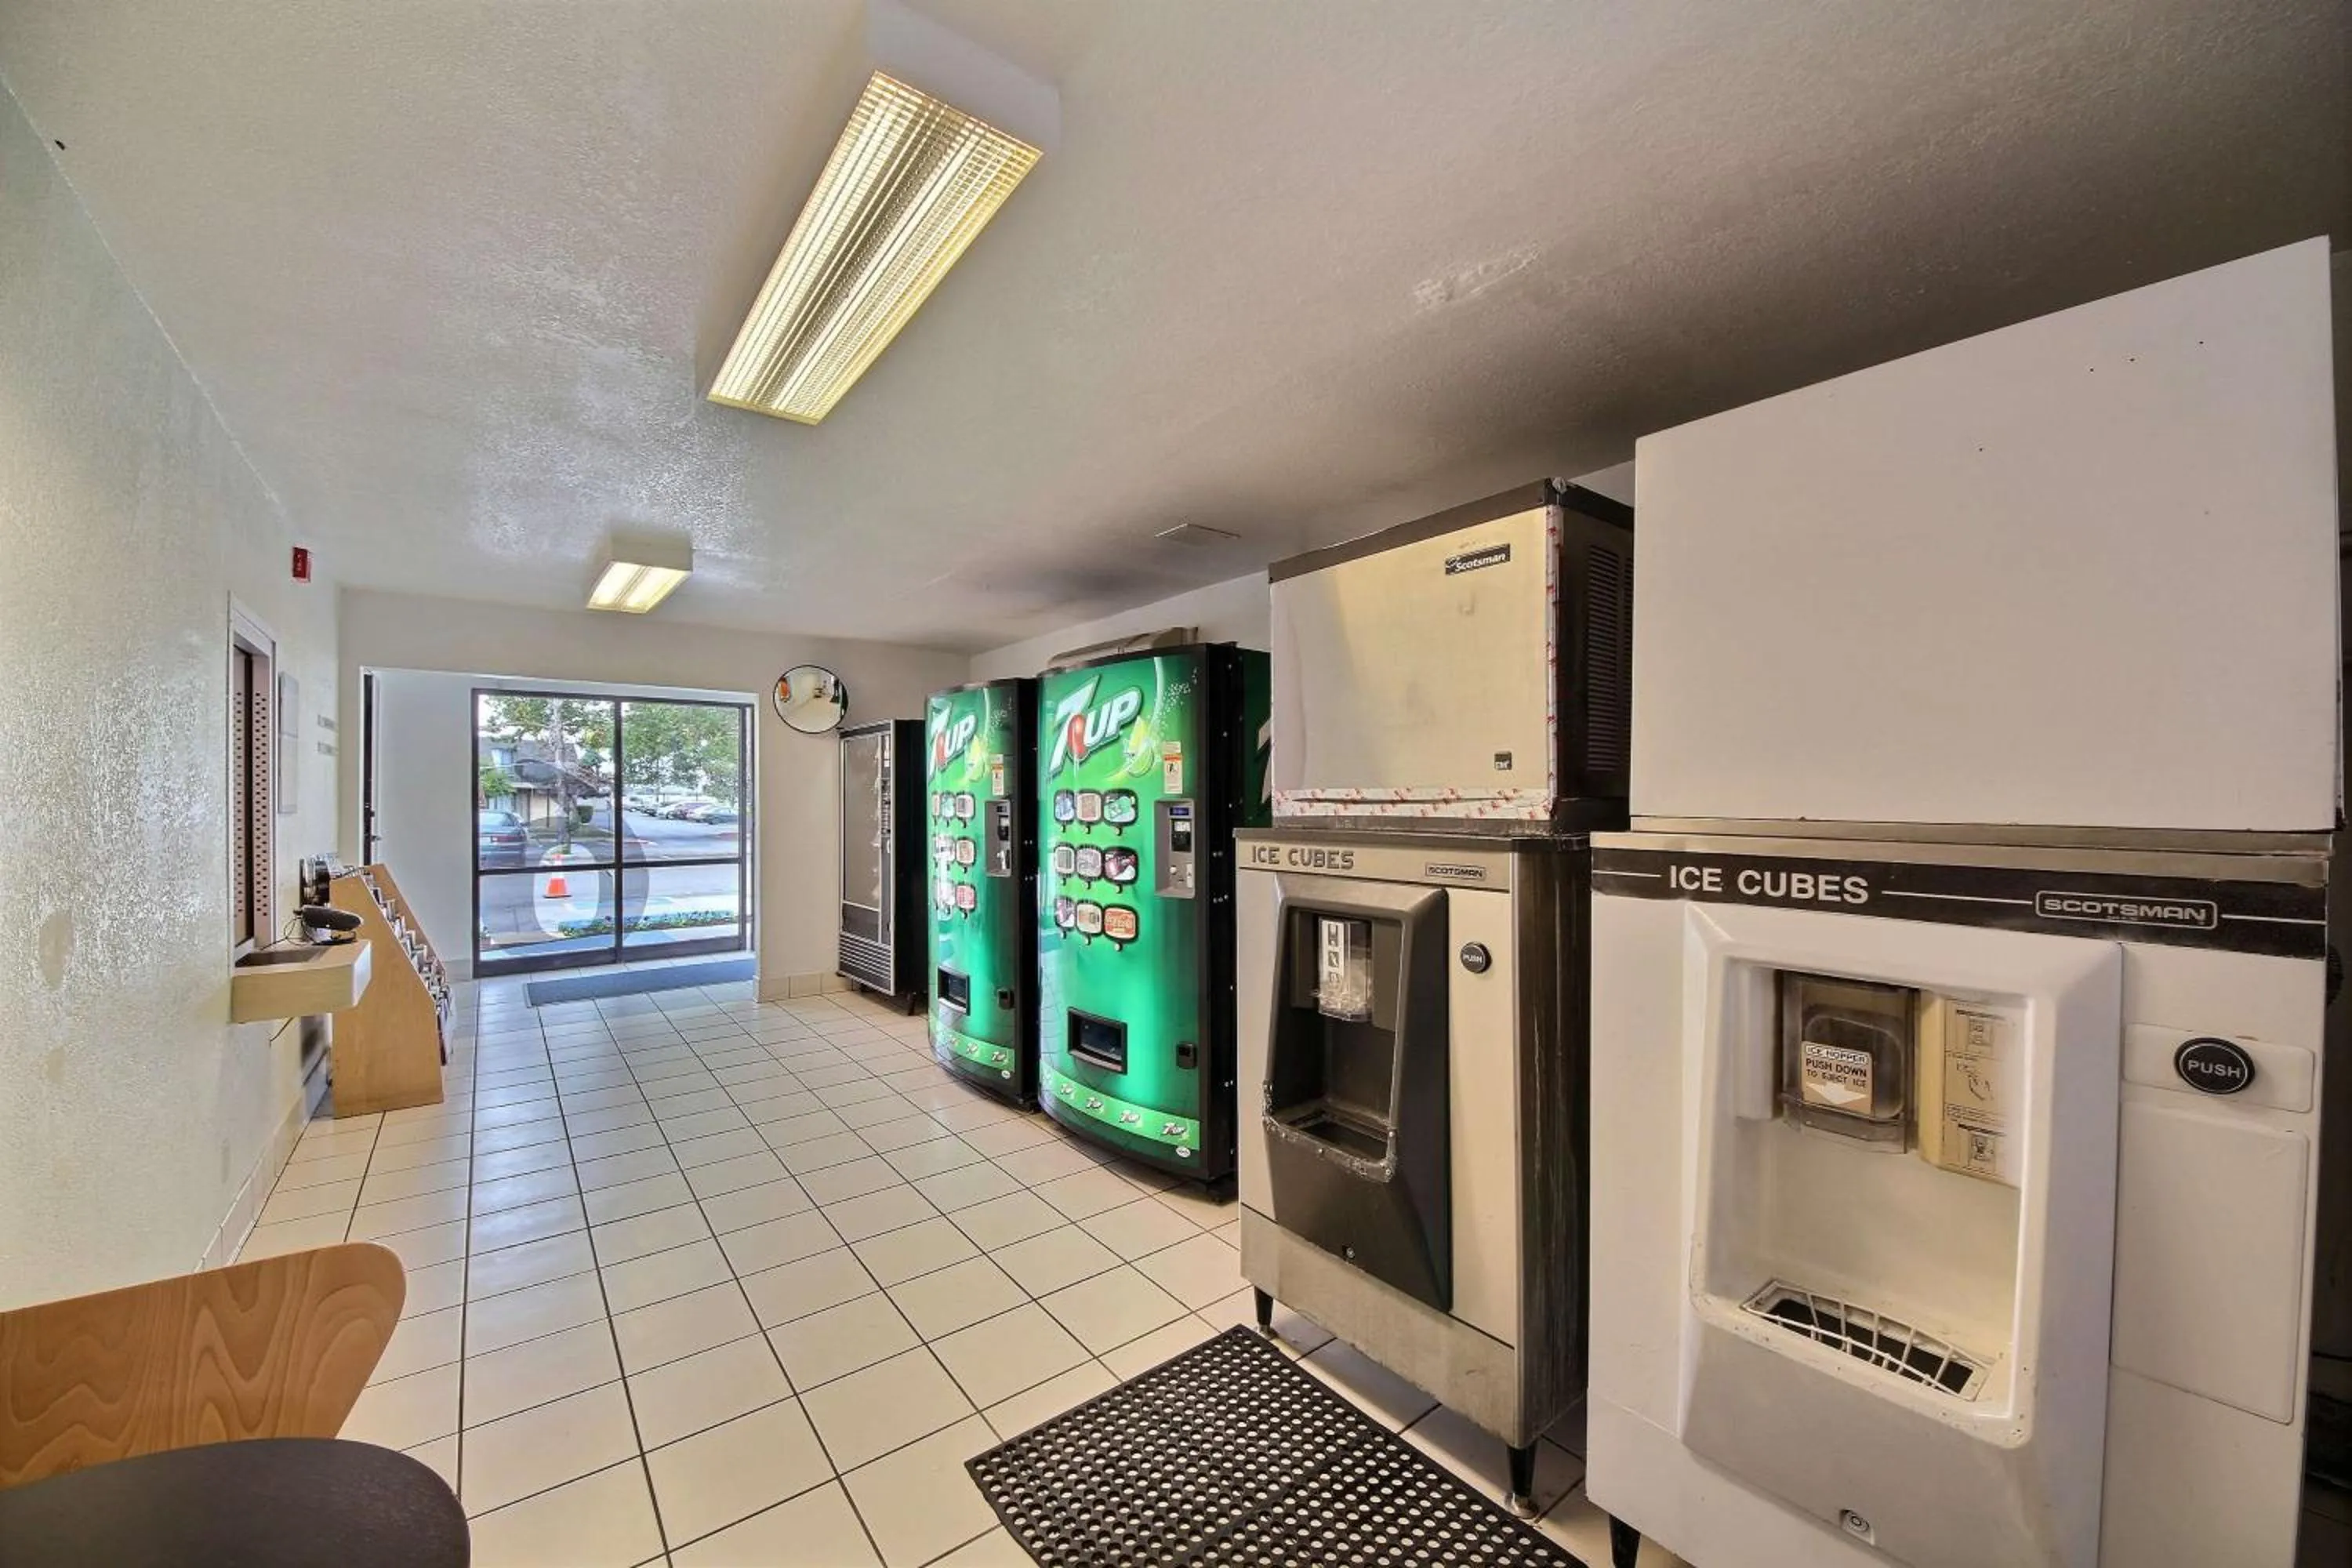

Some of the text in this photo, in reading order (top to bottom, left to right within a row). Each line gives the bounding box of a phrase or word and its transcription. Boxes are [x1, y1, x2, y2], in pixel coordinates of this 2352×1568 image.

[1454, 554, 1506, 572] Scotsman
[1049, 676, 1143, 777] 7UP
[1251, 844, 1355, 870] ICE CUBES
[1428, 866, 1483, 877] SCOTSMAN
[1670, 865, 1869, 904] ICE CUBES
[2044, 899, 2207, 920] SCOTSMAN
[1462, 953, 1483, 963] PUSH
[1806, 1058, 1867, 1077] PUSH DOWN
[2188, 1059, 2241, 1079] PUSH
[1806, 1069, 1818, 1078] TO
[1853, 1078, 1867, 1087] ICE
